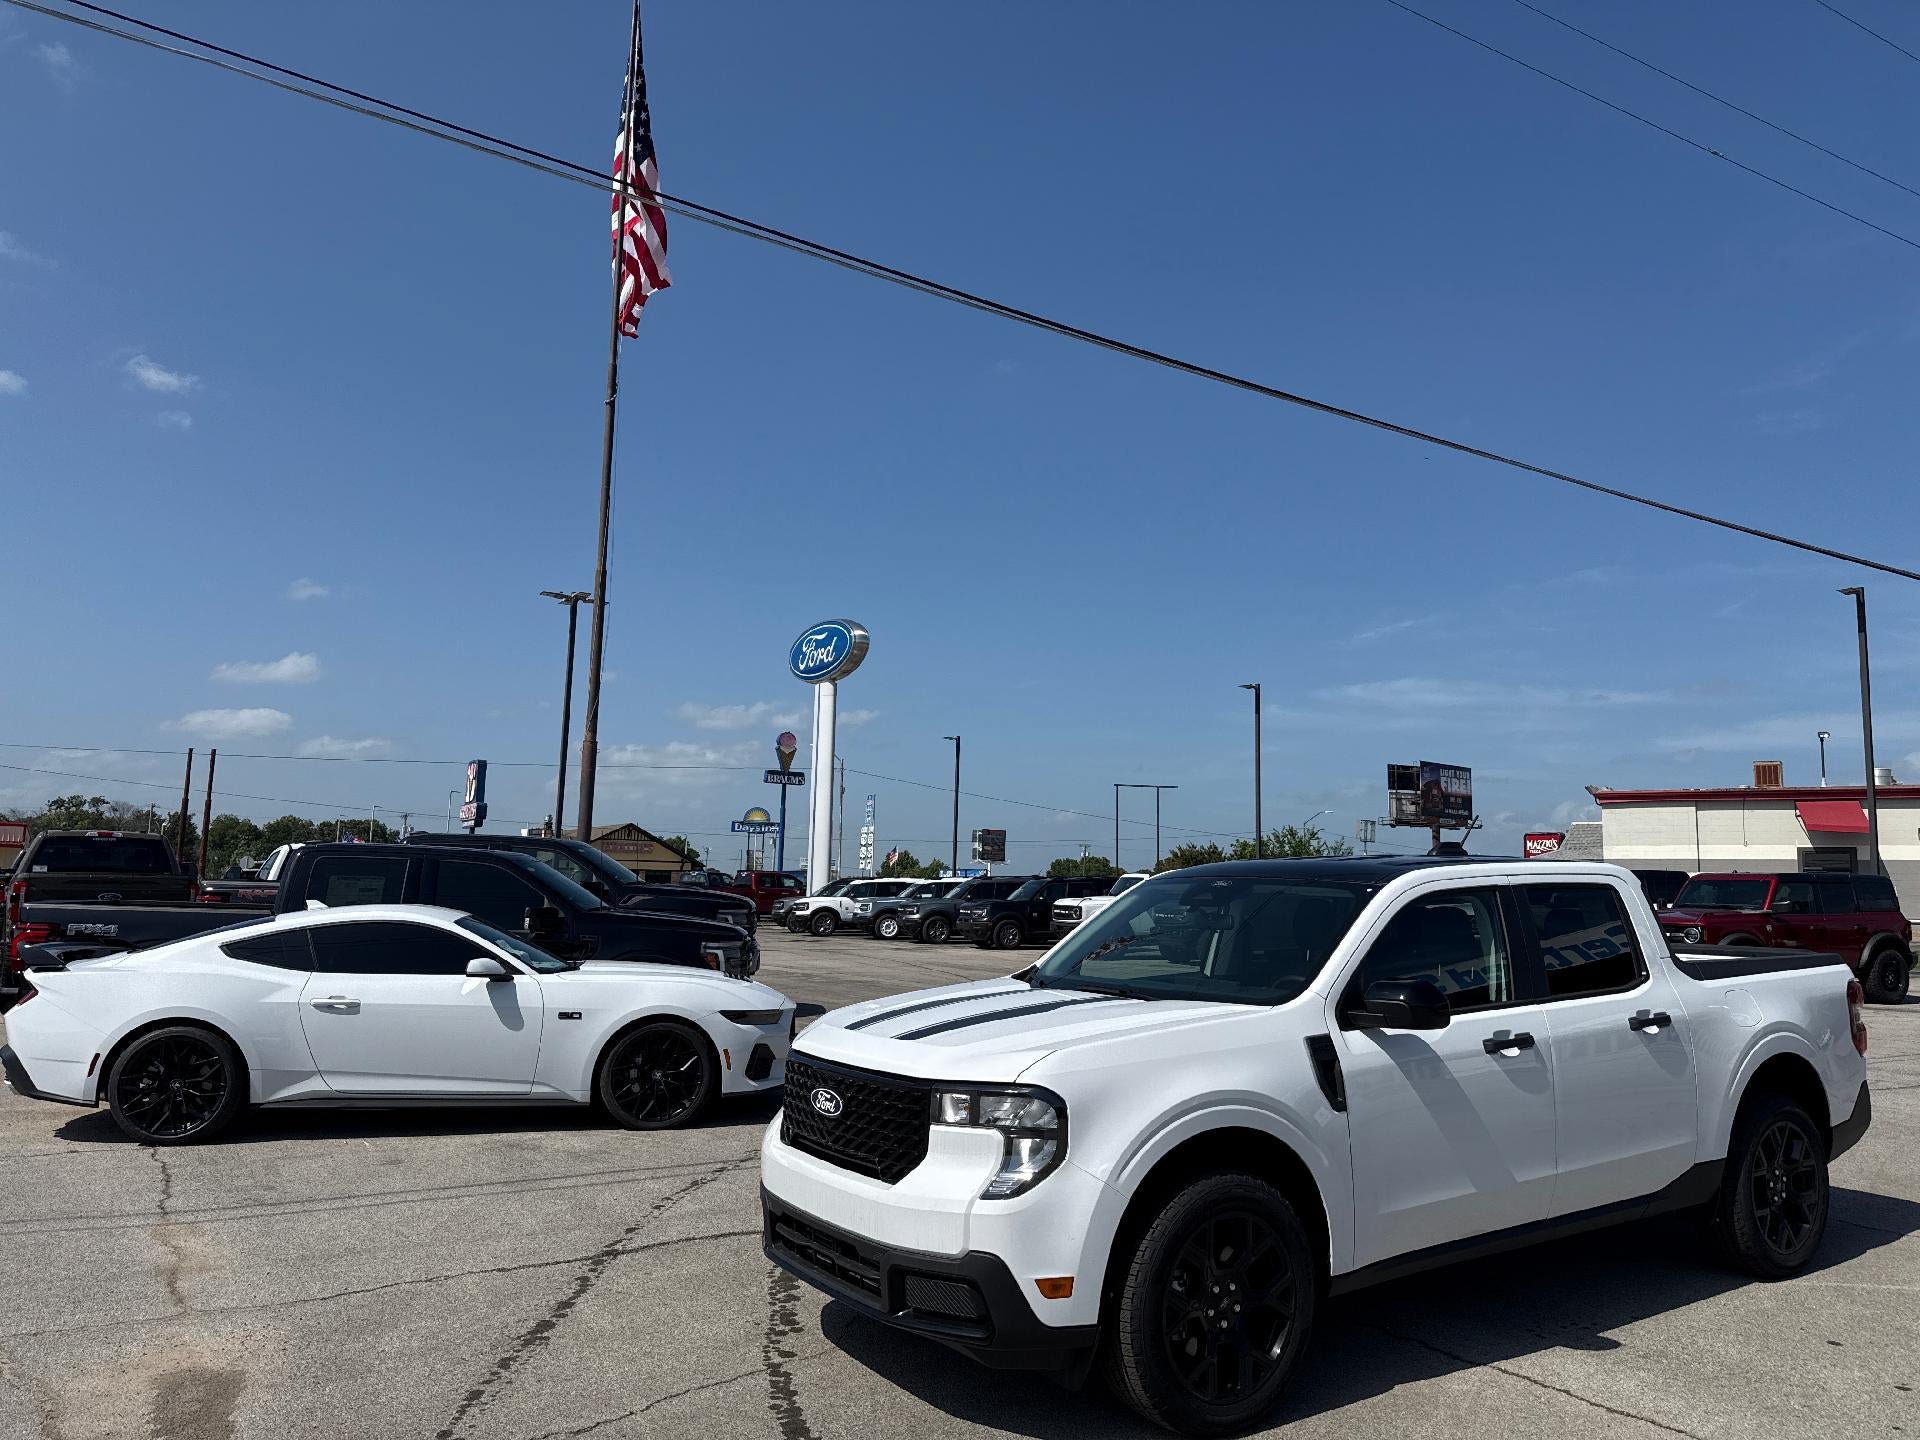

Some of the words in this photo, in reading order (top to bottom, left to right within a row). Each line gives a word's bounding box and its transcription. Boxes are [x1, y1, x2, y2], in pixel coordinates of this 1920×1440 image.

[798, 632, 837, 671] Ford
[734, 822, 760, 832] Days
[1527, 838, 1558, 851] MAZZIO'S
[67, 923, 118, 937] FX4
[816, 1090, 836, 1112] Ford
